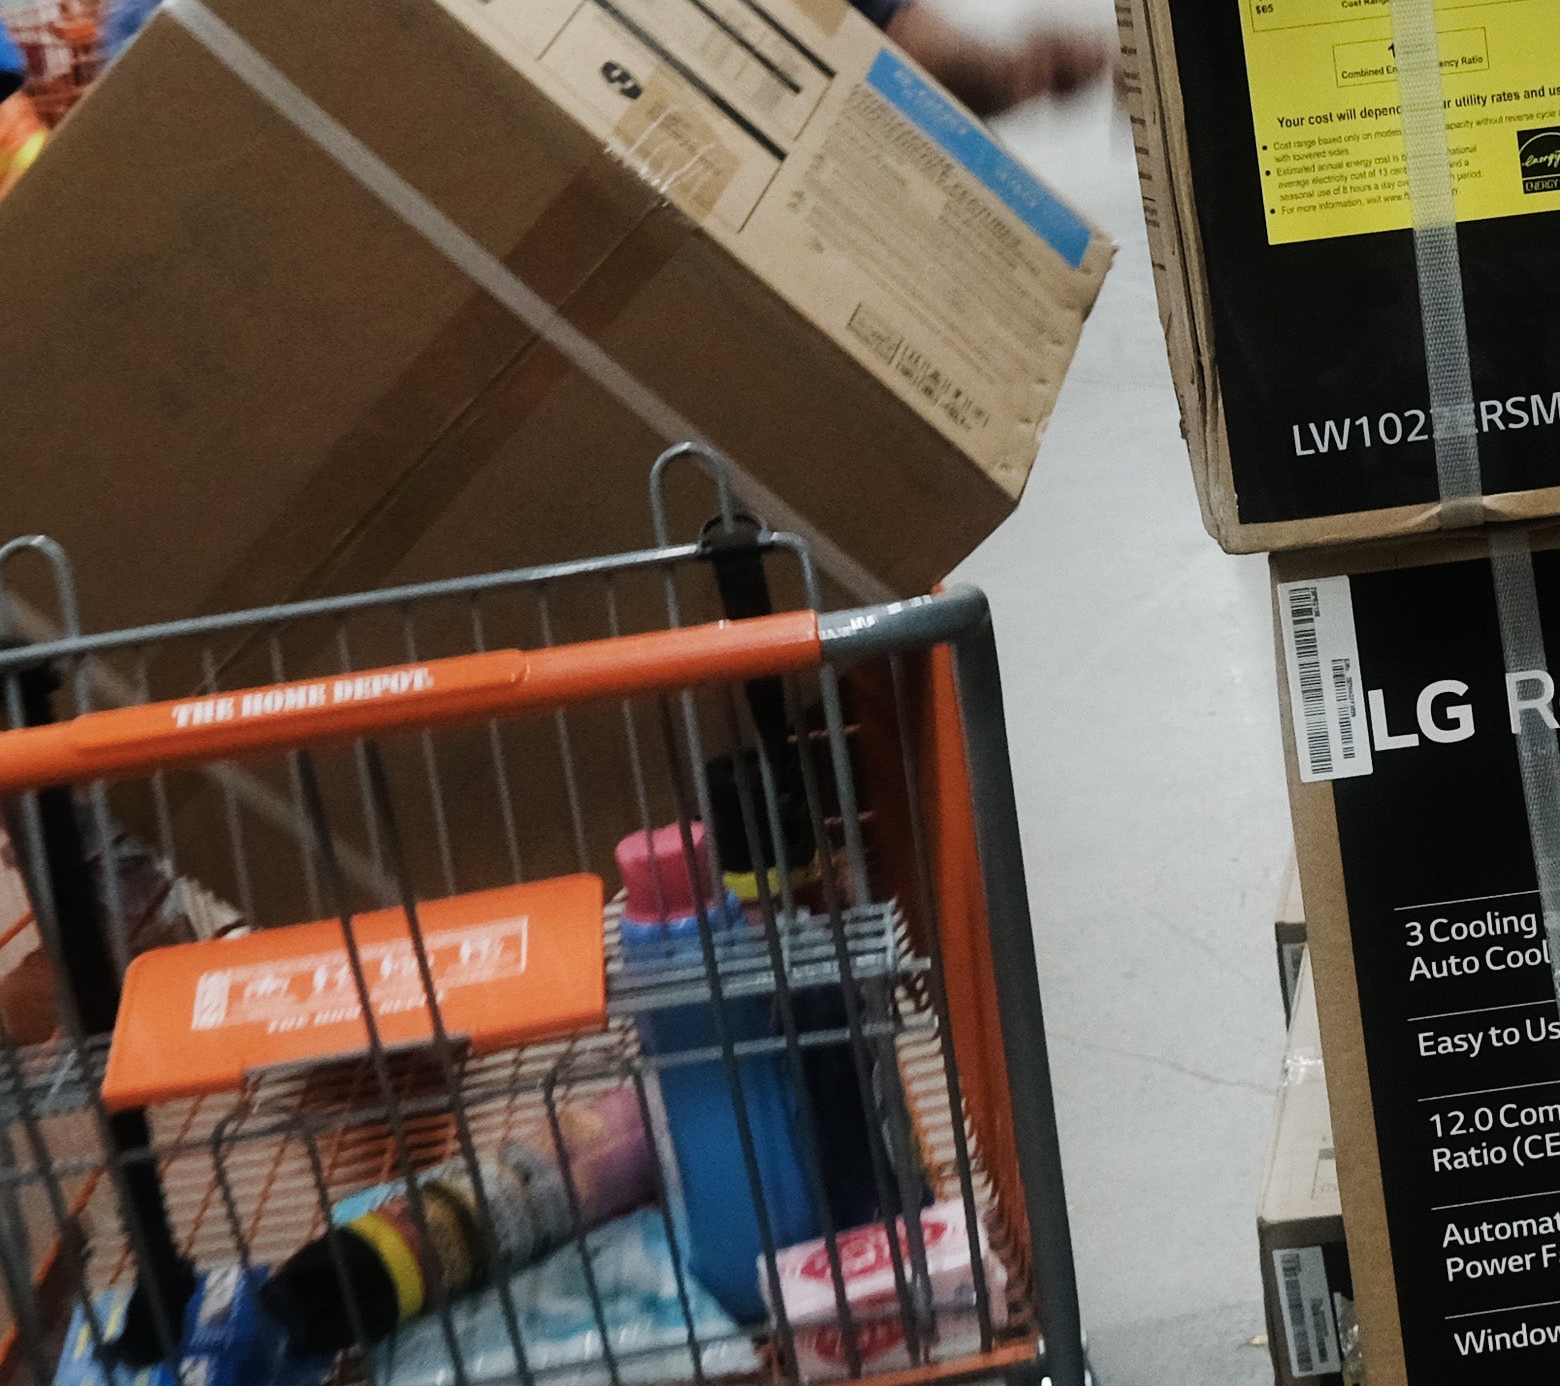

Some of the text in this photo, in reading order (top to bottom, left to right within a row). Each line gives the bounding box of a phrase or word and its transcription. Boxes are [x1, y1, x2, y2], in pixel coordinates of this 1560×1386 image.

[1277, 113, 1308, 128] Your
[1306, 109, 1334, 124] cost
[1338, 105, 1356, 122] will
[1454, 93, 1488, 112] utility
[1489, 91, 1519, 107] rates
[1523, 88, 1546, 103] and
[172, 697, 235, 729] THE
[240, 682, 326, 719] HOME
[1369, 680, 1474, 751] LG
[1405, 920, 1424, 947] 3
[1429, 908, 1537, 948] Cooling
[1409, 933, 1551, 980] Auto Cool
[1418, 1027, 1484, 1059] Easy
[1488, 1018, 1518, 1045] to
[1428, 1107, 1494, 1138] 12.0
[1432, 1142, 1507, 1173] Ratio
[1446, 1248, 1535, 1281] Power
